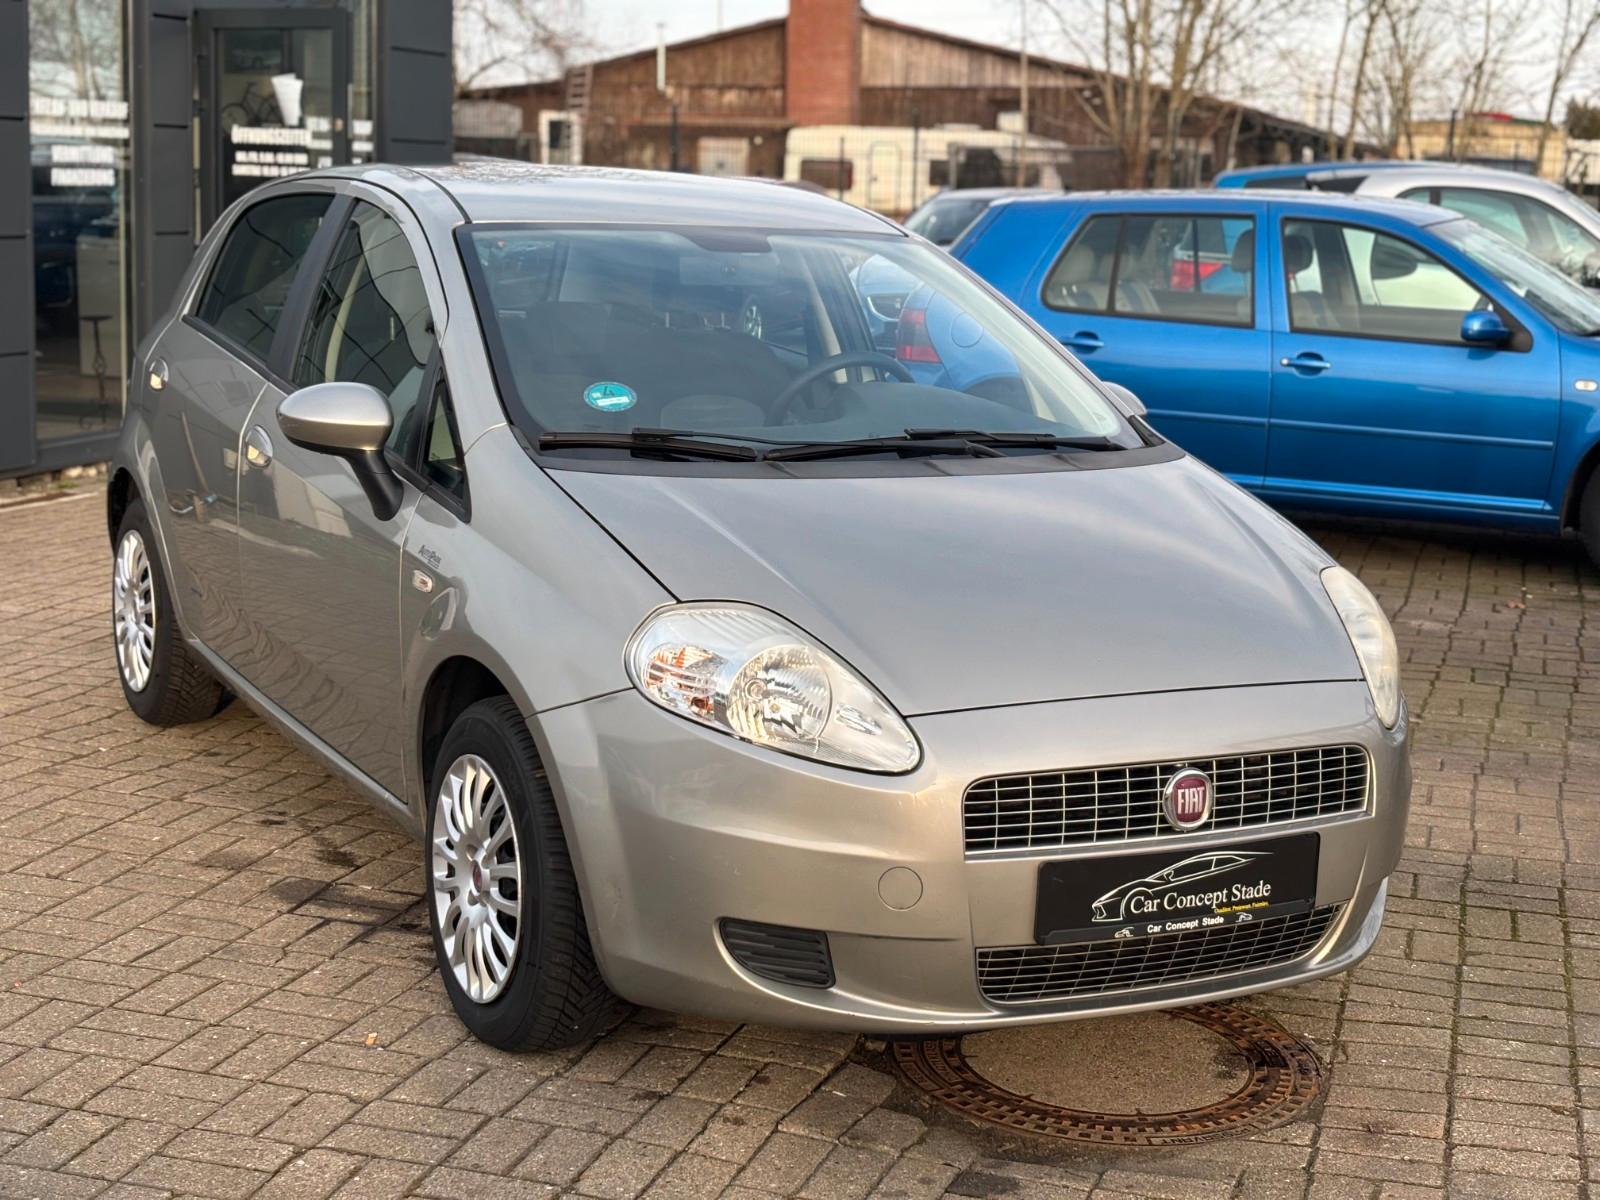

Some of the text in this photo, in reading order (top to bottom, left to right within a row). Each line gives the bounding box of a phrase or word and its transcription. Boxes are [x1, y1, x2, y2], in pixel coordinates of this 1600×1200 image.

[1177, 786, 1205, 814] FIAT
[1130, 896, 1160, 914] Car
[1164, 889, 1227, 909] Concept
[1231, 880, 1271, 901] Stade
[1147, 916, 1224, 933] Car Concept Stade
